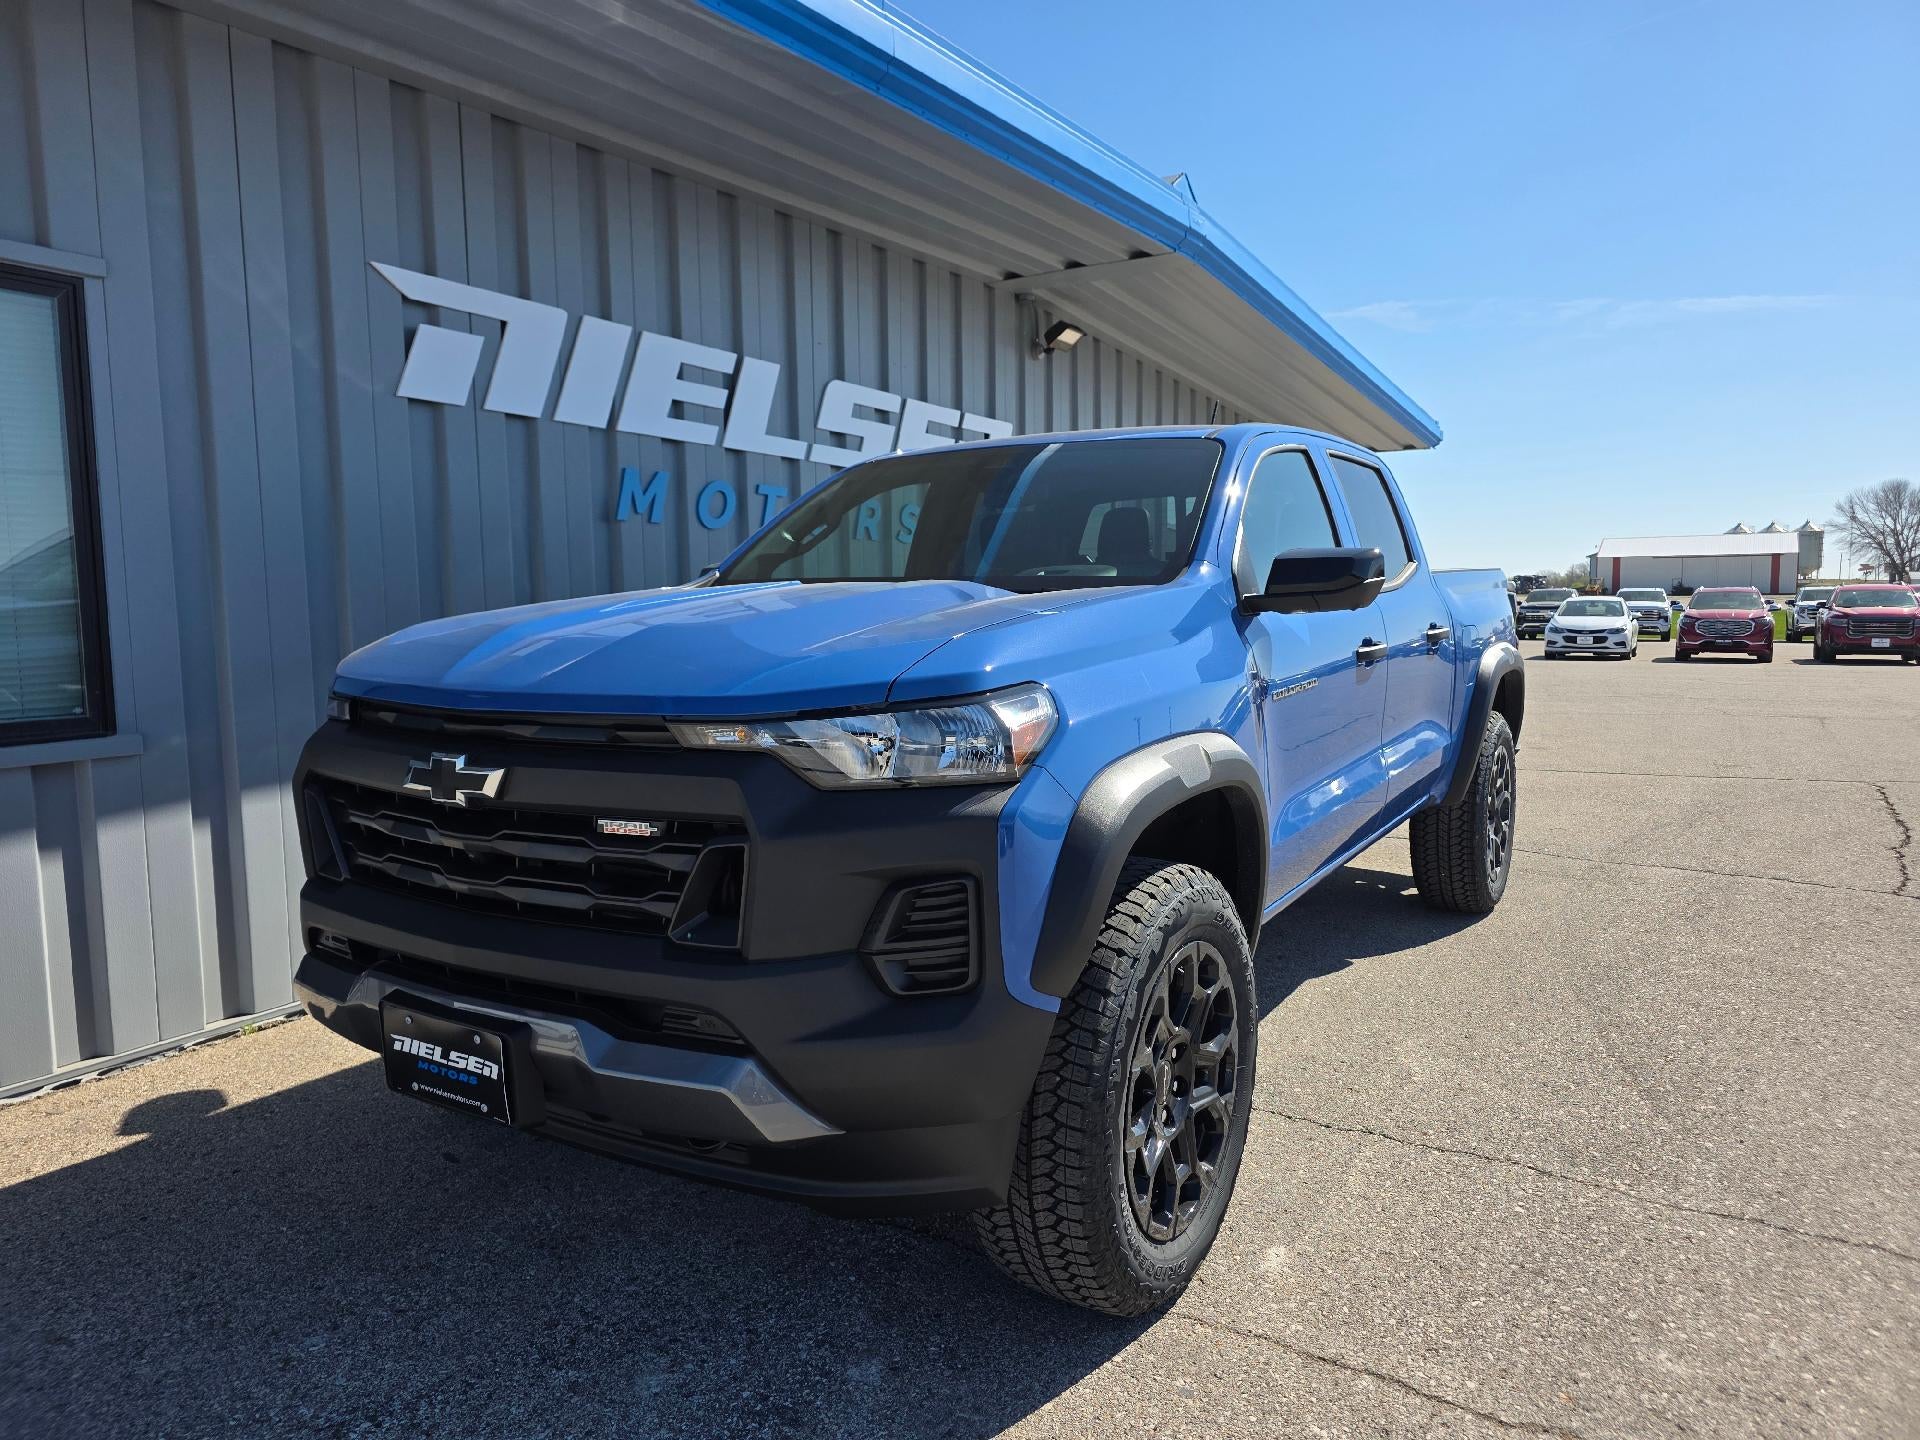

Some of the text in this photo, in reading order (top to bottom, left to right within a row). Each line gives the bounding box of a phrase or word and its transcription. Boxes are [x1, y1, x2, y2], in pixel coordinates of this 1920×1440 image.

[616, 466, 921, 545] MOTRS
[390, 1033, 499, 1080] NIELSEN
[416, 1060, 479, 1085] MOTORS
